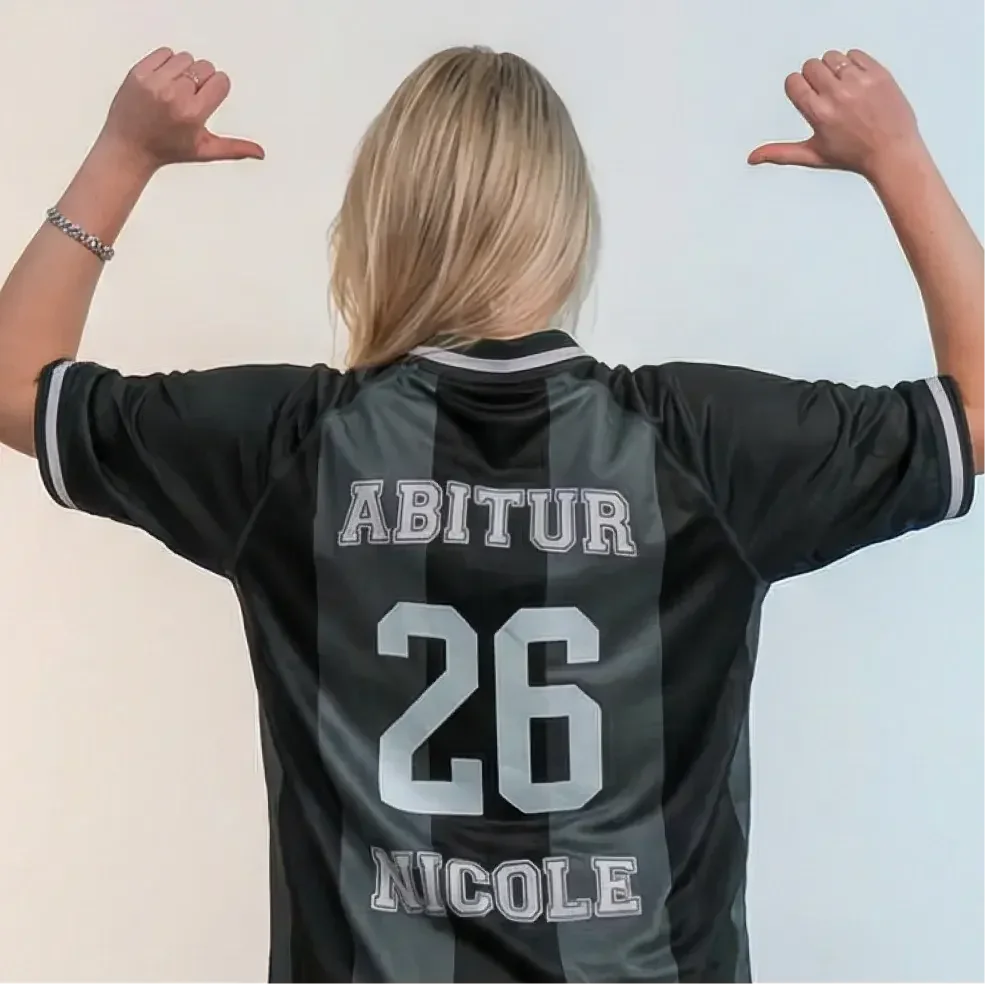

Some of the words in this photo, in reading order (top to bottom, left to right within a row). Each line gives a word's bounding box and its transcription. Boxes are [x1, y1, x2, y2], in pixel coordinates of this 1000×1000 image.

[338, 480, 638, 557] ABITUR
[377, 601, 603, 815] 26
[370, 847, 643, 923] NICOLE
